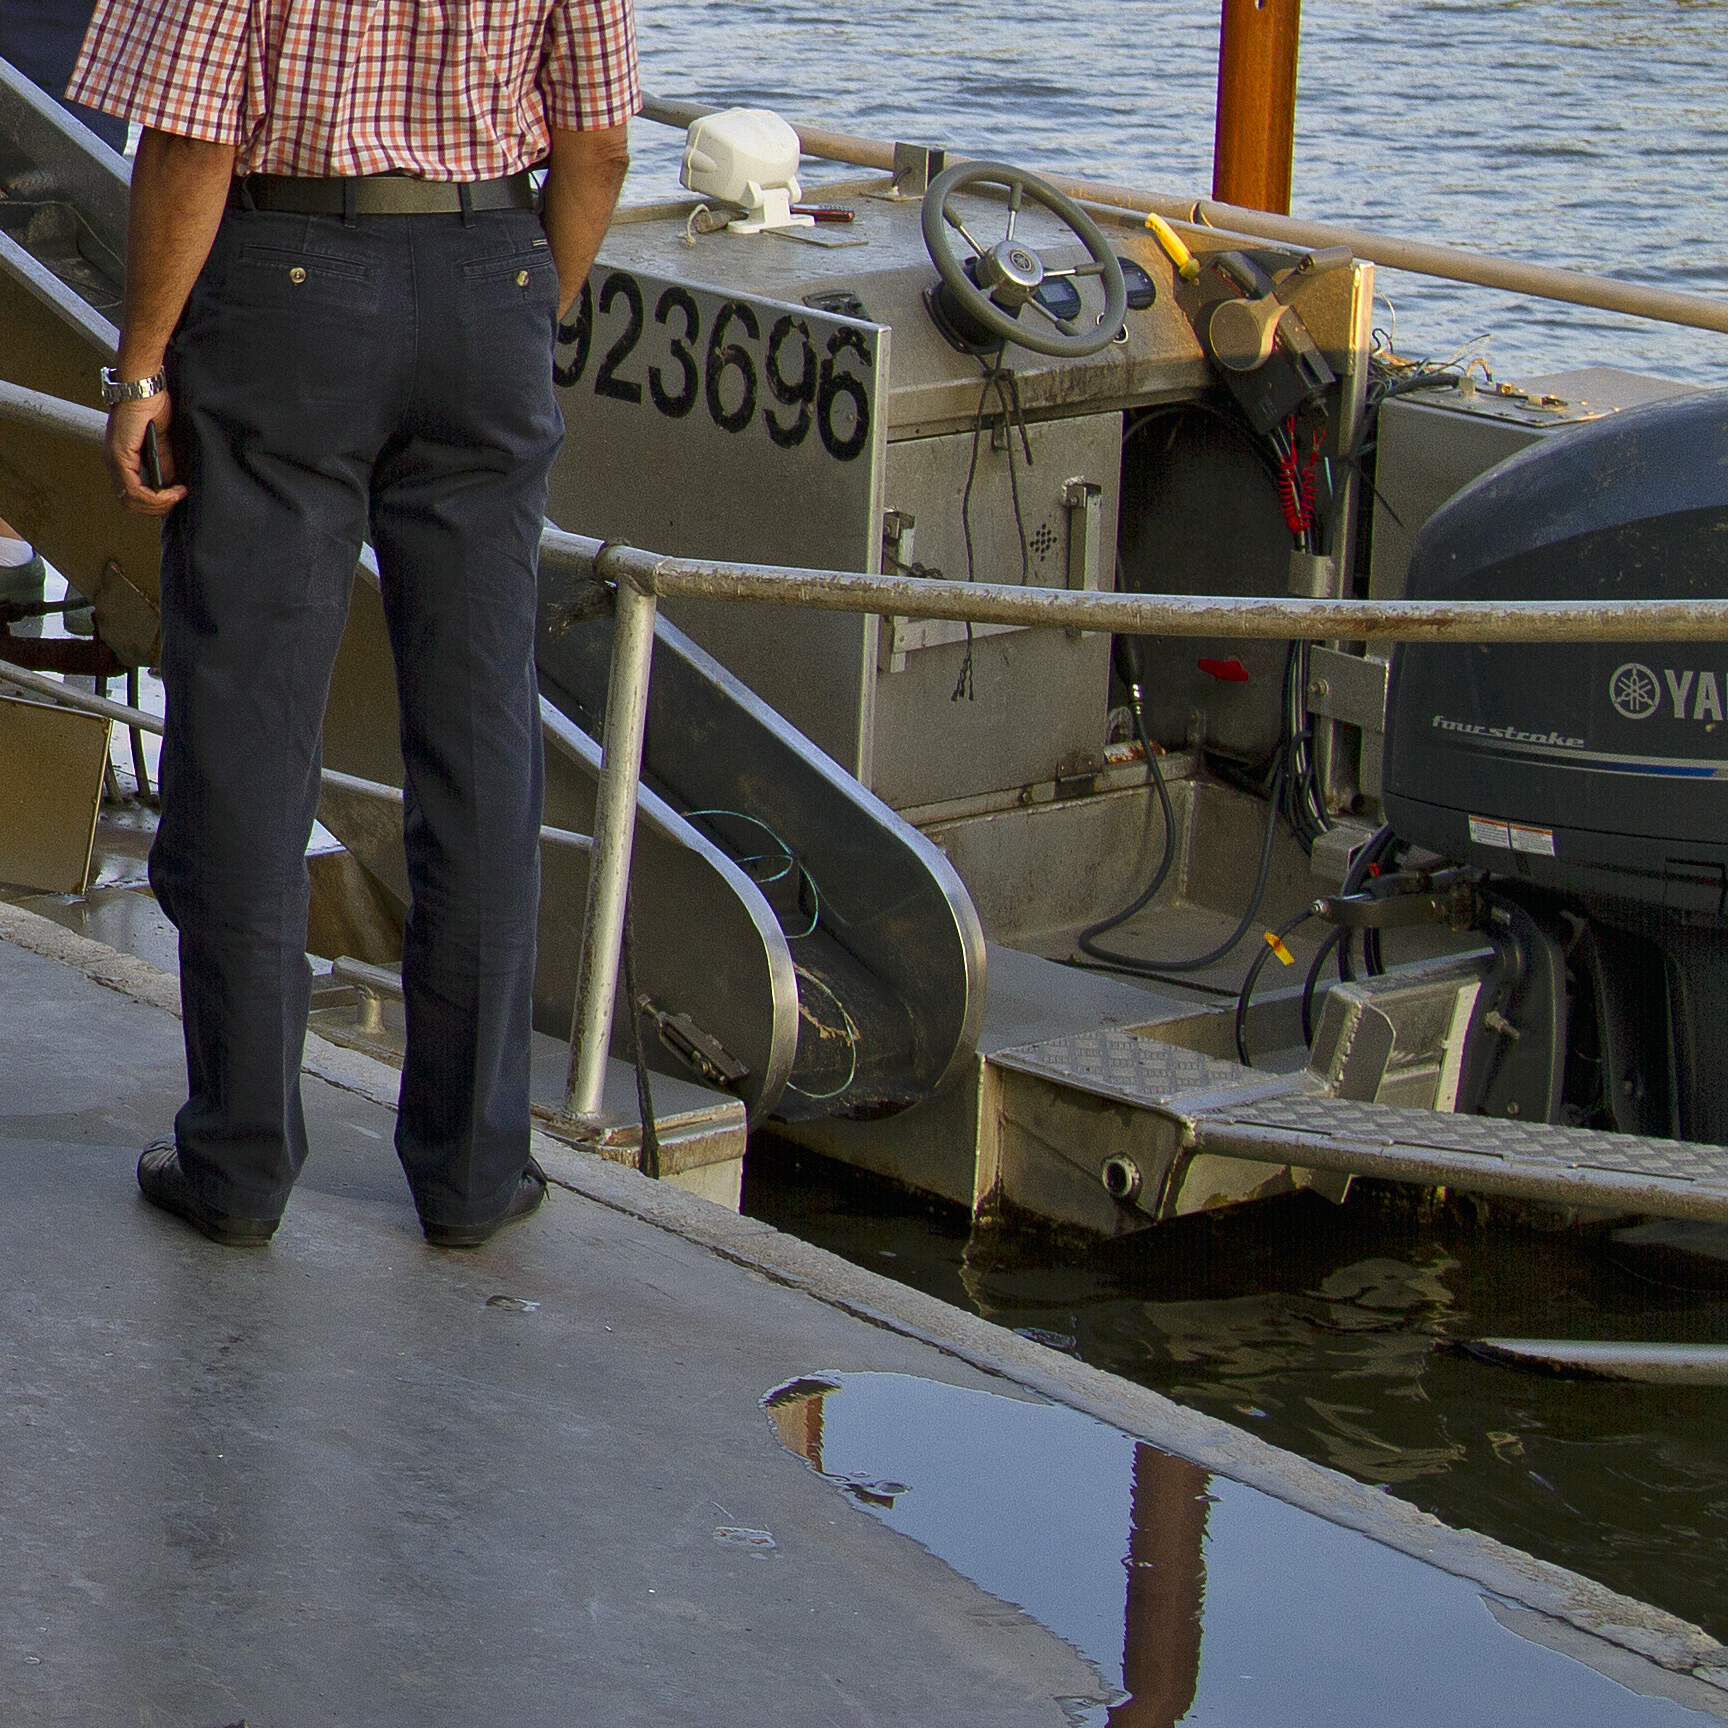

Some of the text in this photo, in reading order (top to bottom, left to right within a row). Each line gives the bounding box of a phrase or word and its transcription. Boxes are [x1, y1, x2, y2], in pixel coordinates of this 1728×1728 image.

[552, 273, 872, 462] 923696
[1664, 669, 1728, 721] YA
[1489, 726, 1585, 748] stroke
